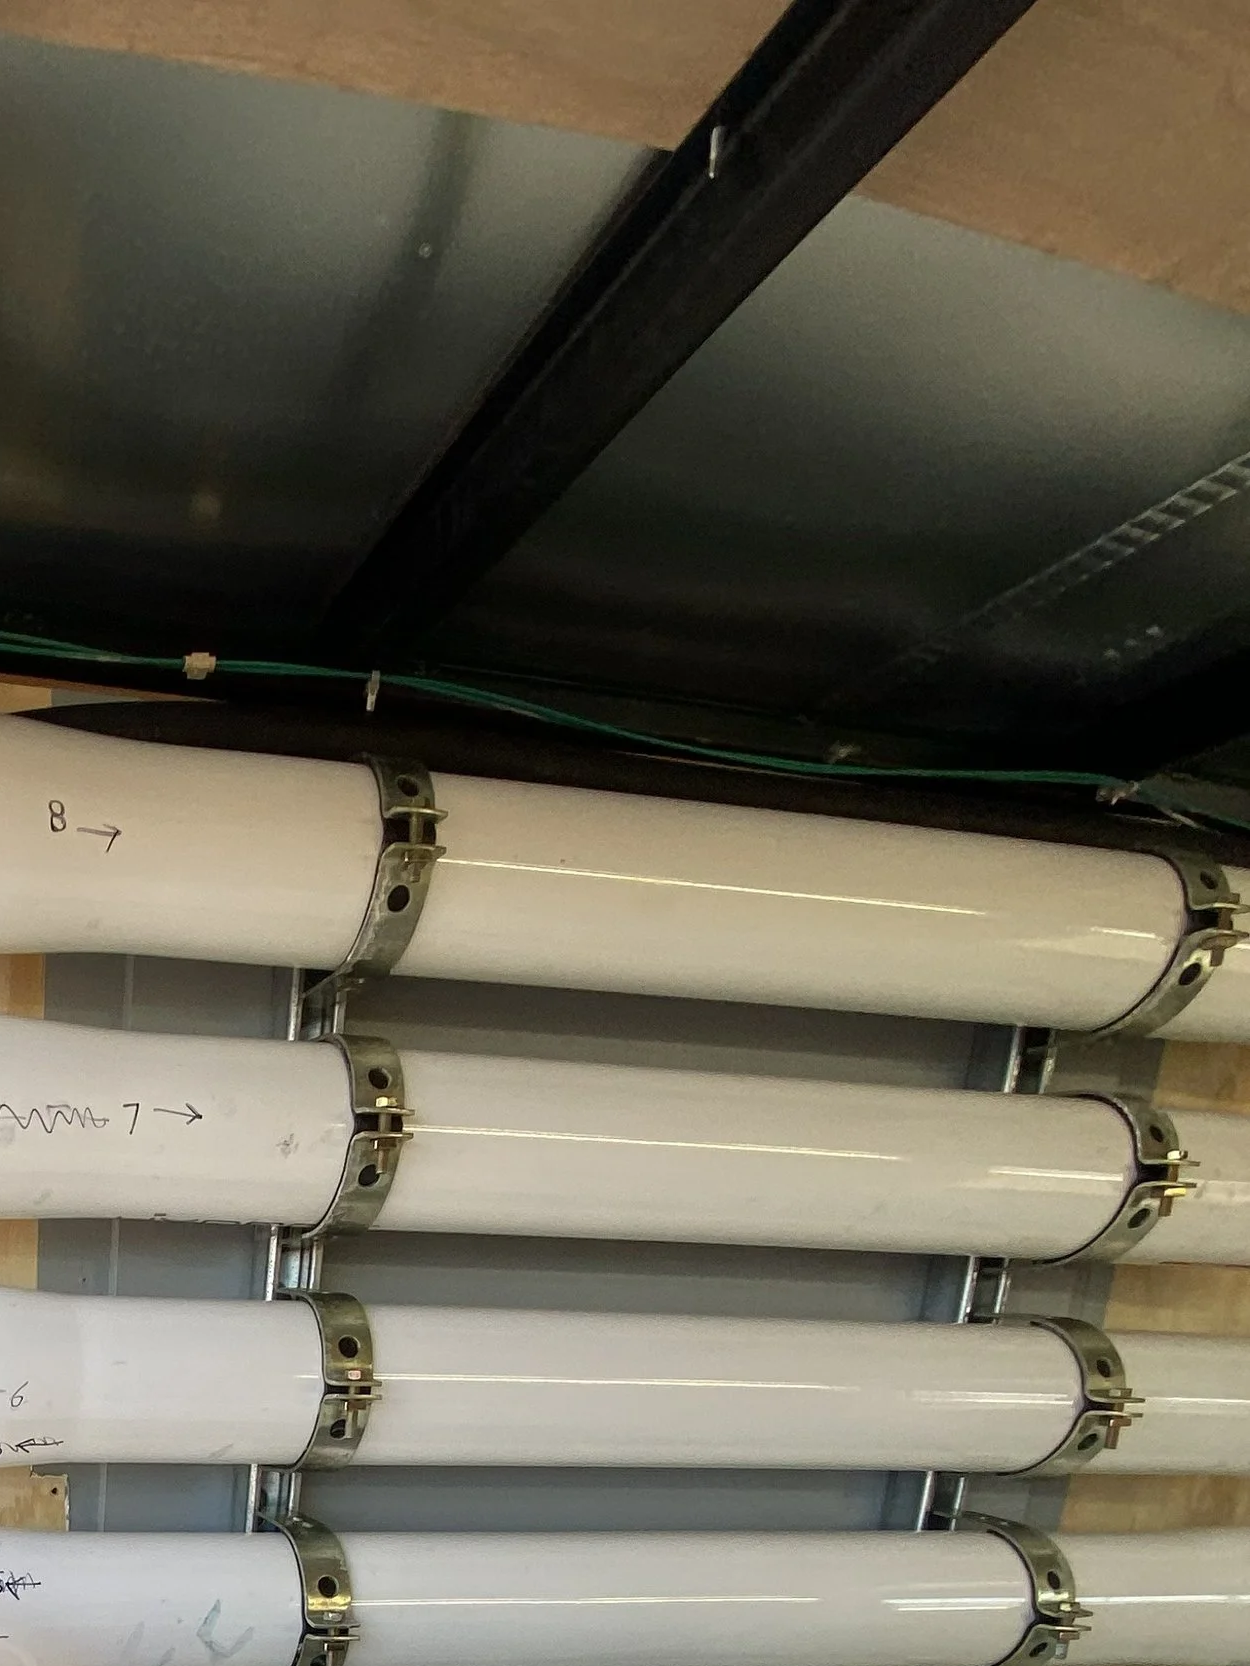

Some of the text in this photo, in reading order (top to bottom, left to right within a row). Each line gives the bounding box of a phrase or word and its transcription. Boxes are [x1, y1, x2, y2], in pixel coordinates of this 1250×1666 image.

[48, 799, 66, 832] 8
[122, 1102, 140, 1135] 7
[10, 1380, 29, 1408] 6
